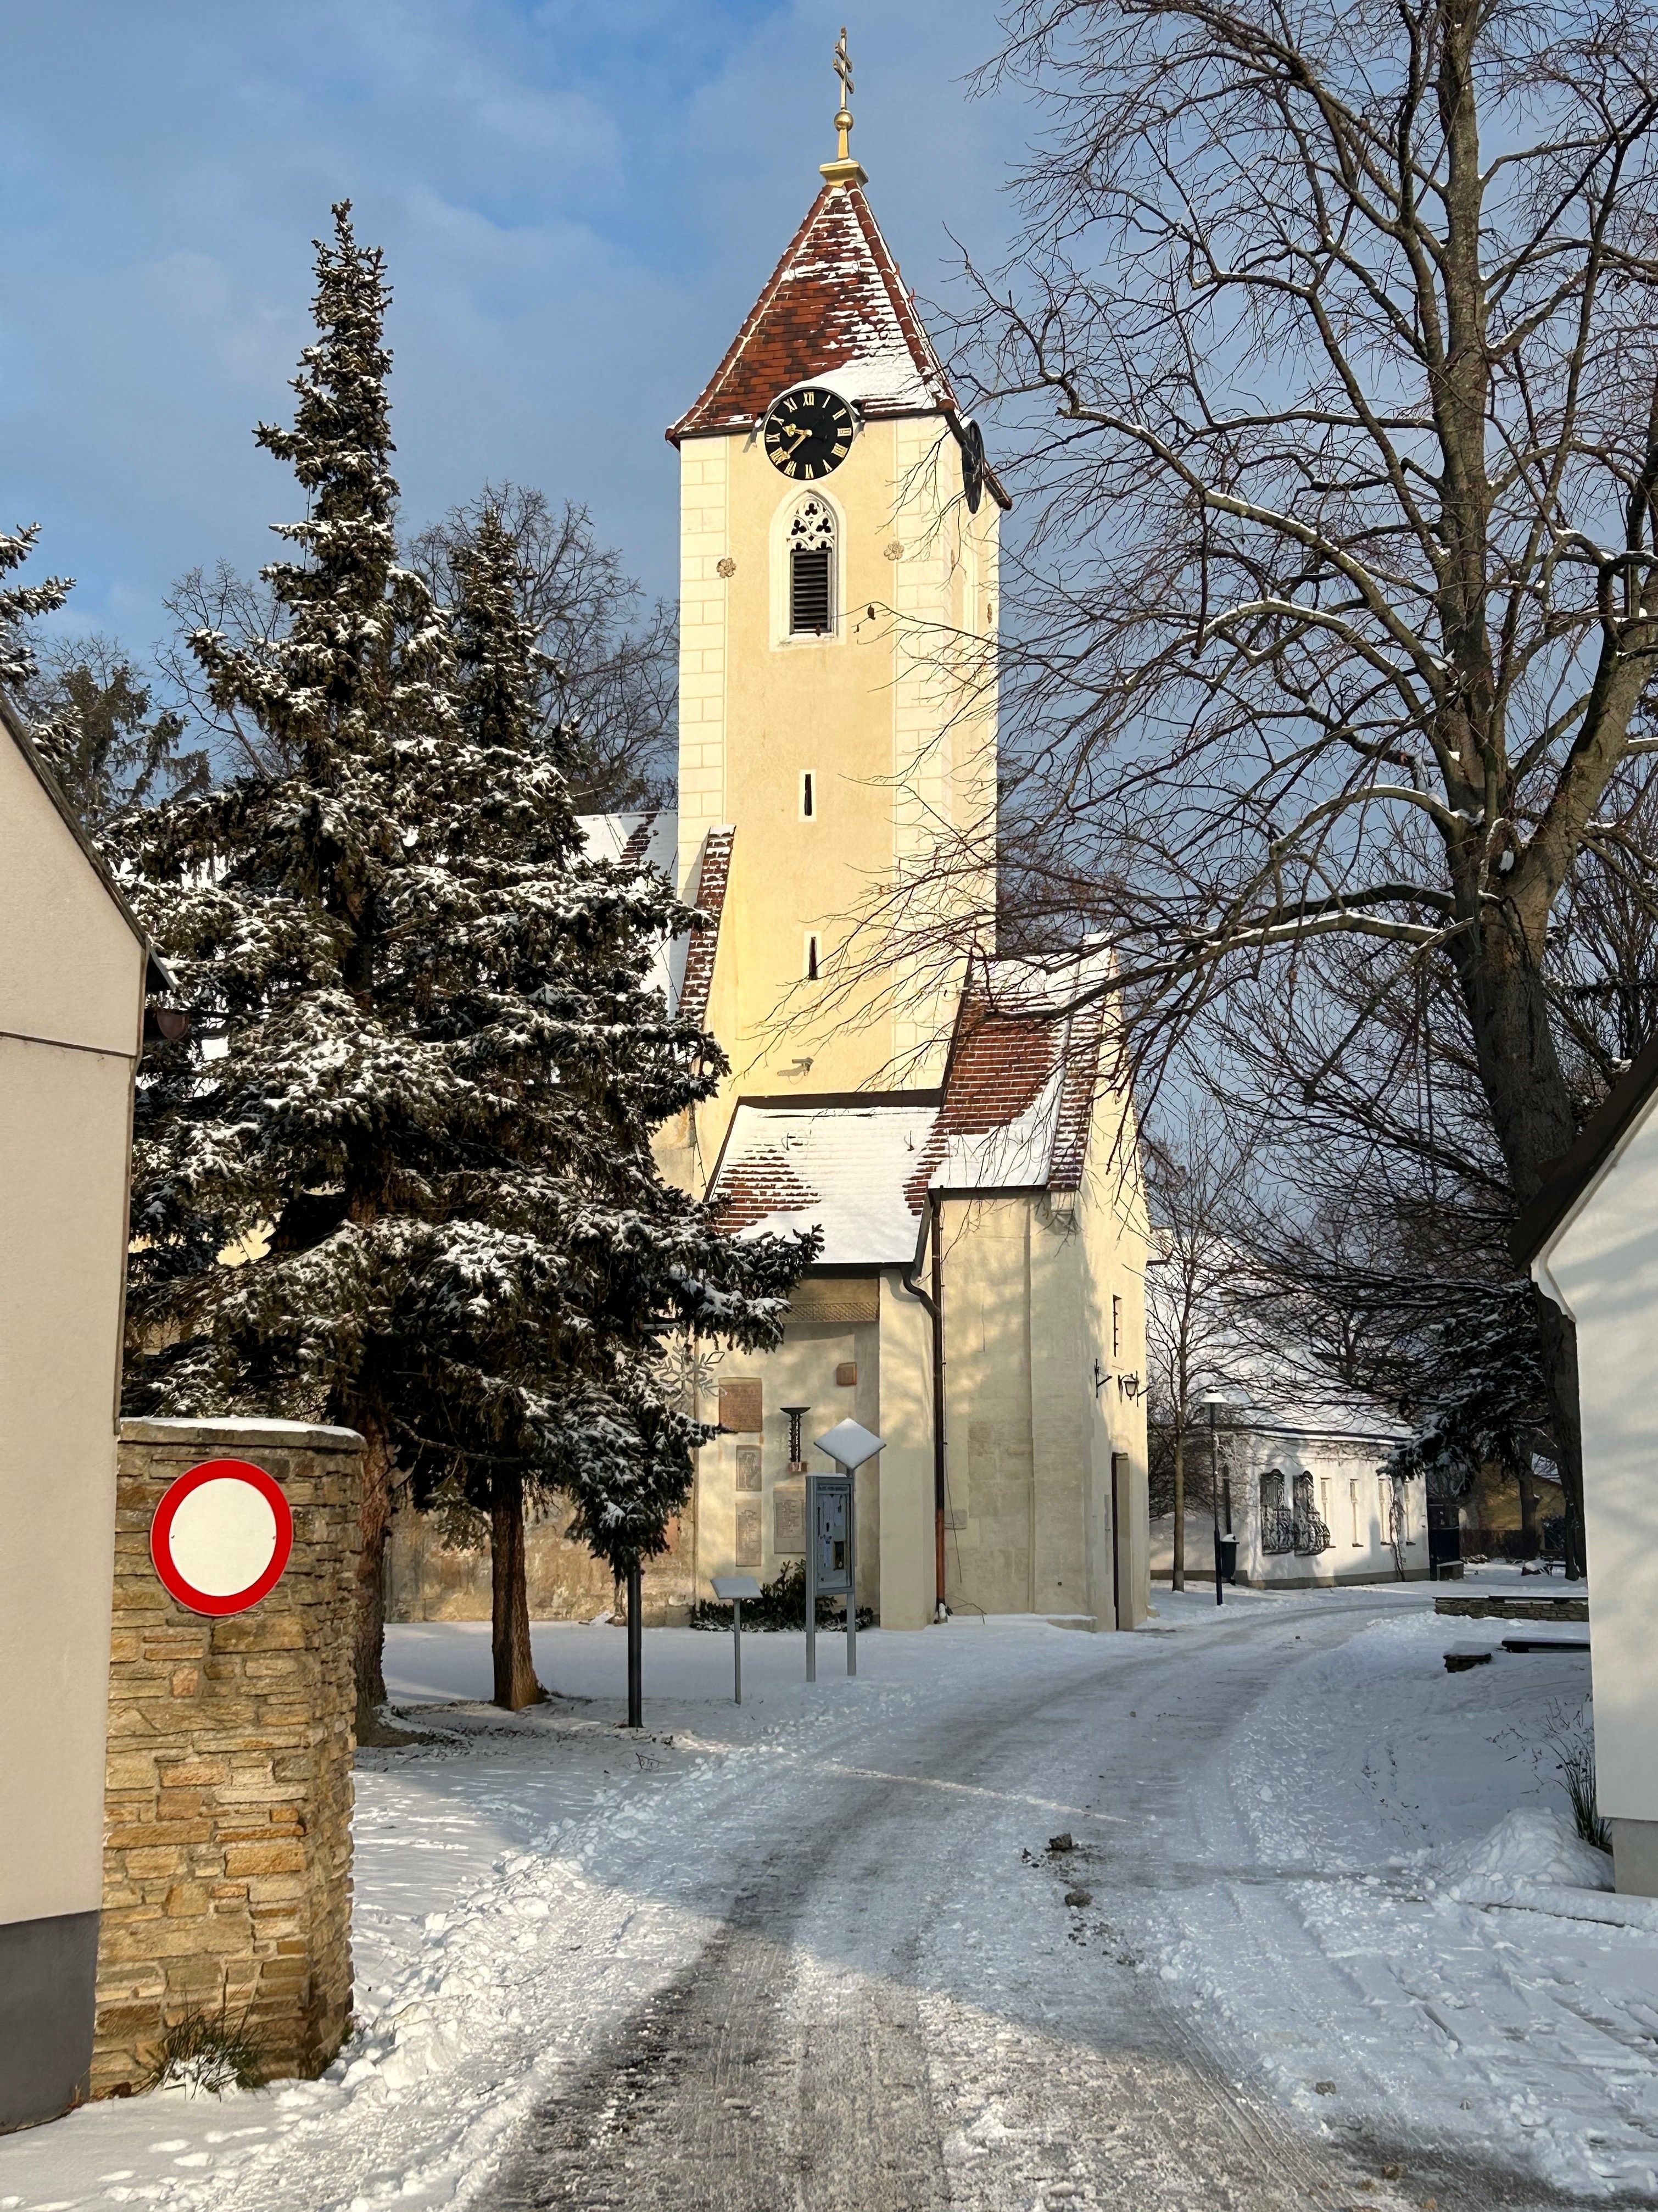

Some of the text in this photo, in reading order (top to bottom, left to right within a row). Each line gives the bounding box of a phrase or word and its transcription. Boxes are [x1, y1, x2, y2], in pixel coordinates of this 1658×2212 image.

[783, 397, 798, 413] XI
[803, 392, 814, 406] XII
[822, 395, 831, 408] I
[770, 414, 785, 426] X
[833, 408, 847, 421] II
[766, 432, 780, 443] IX
[837, 427, 852, 437] III
[784, 461, 797, 477] VII
[805, 464, 814, 479] VI
[823, 459, 833, 473] V
